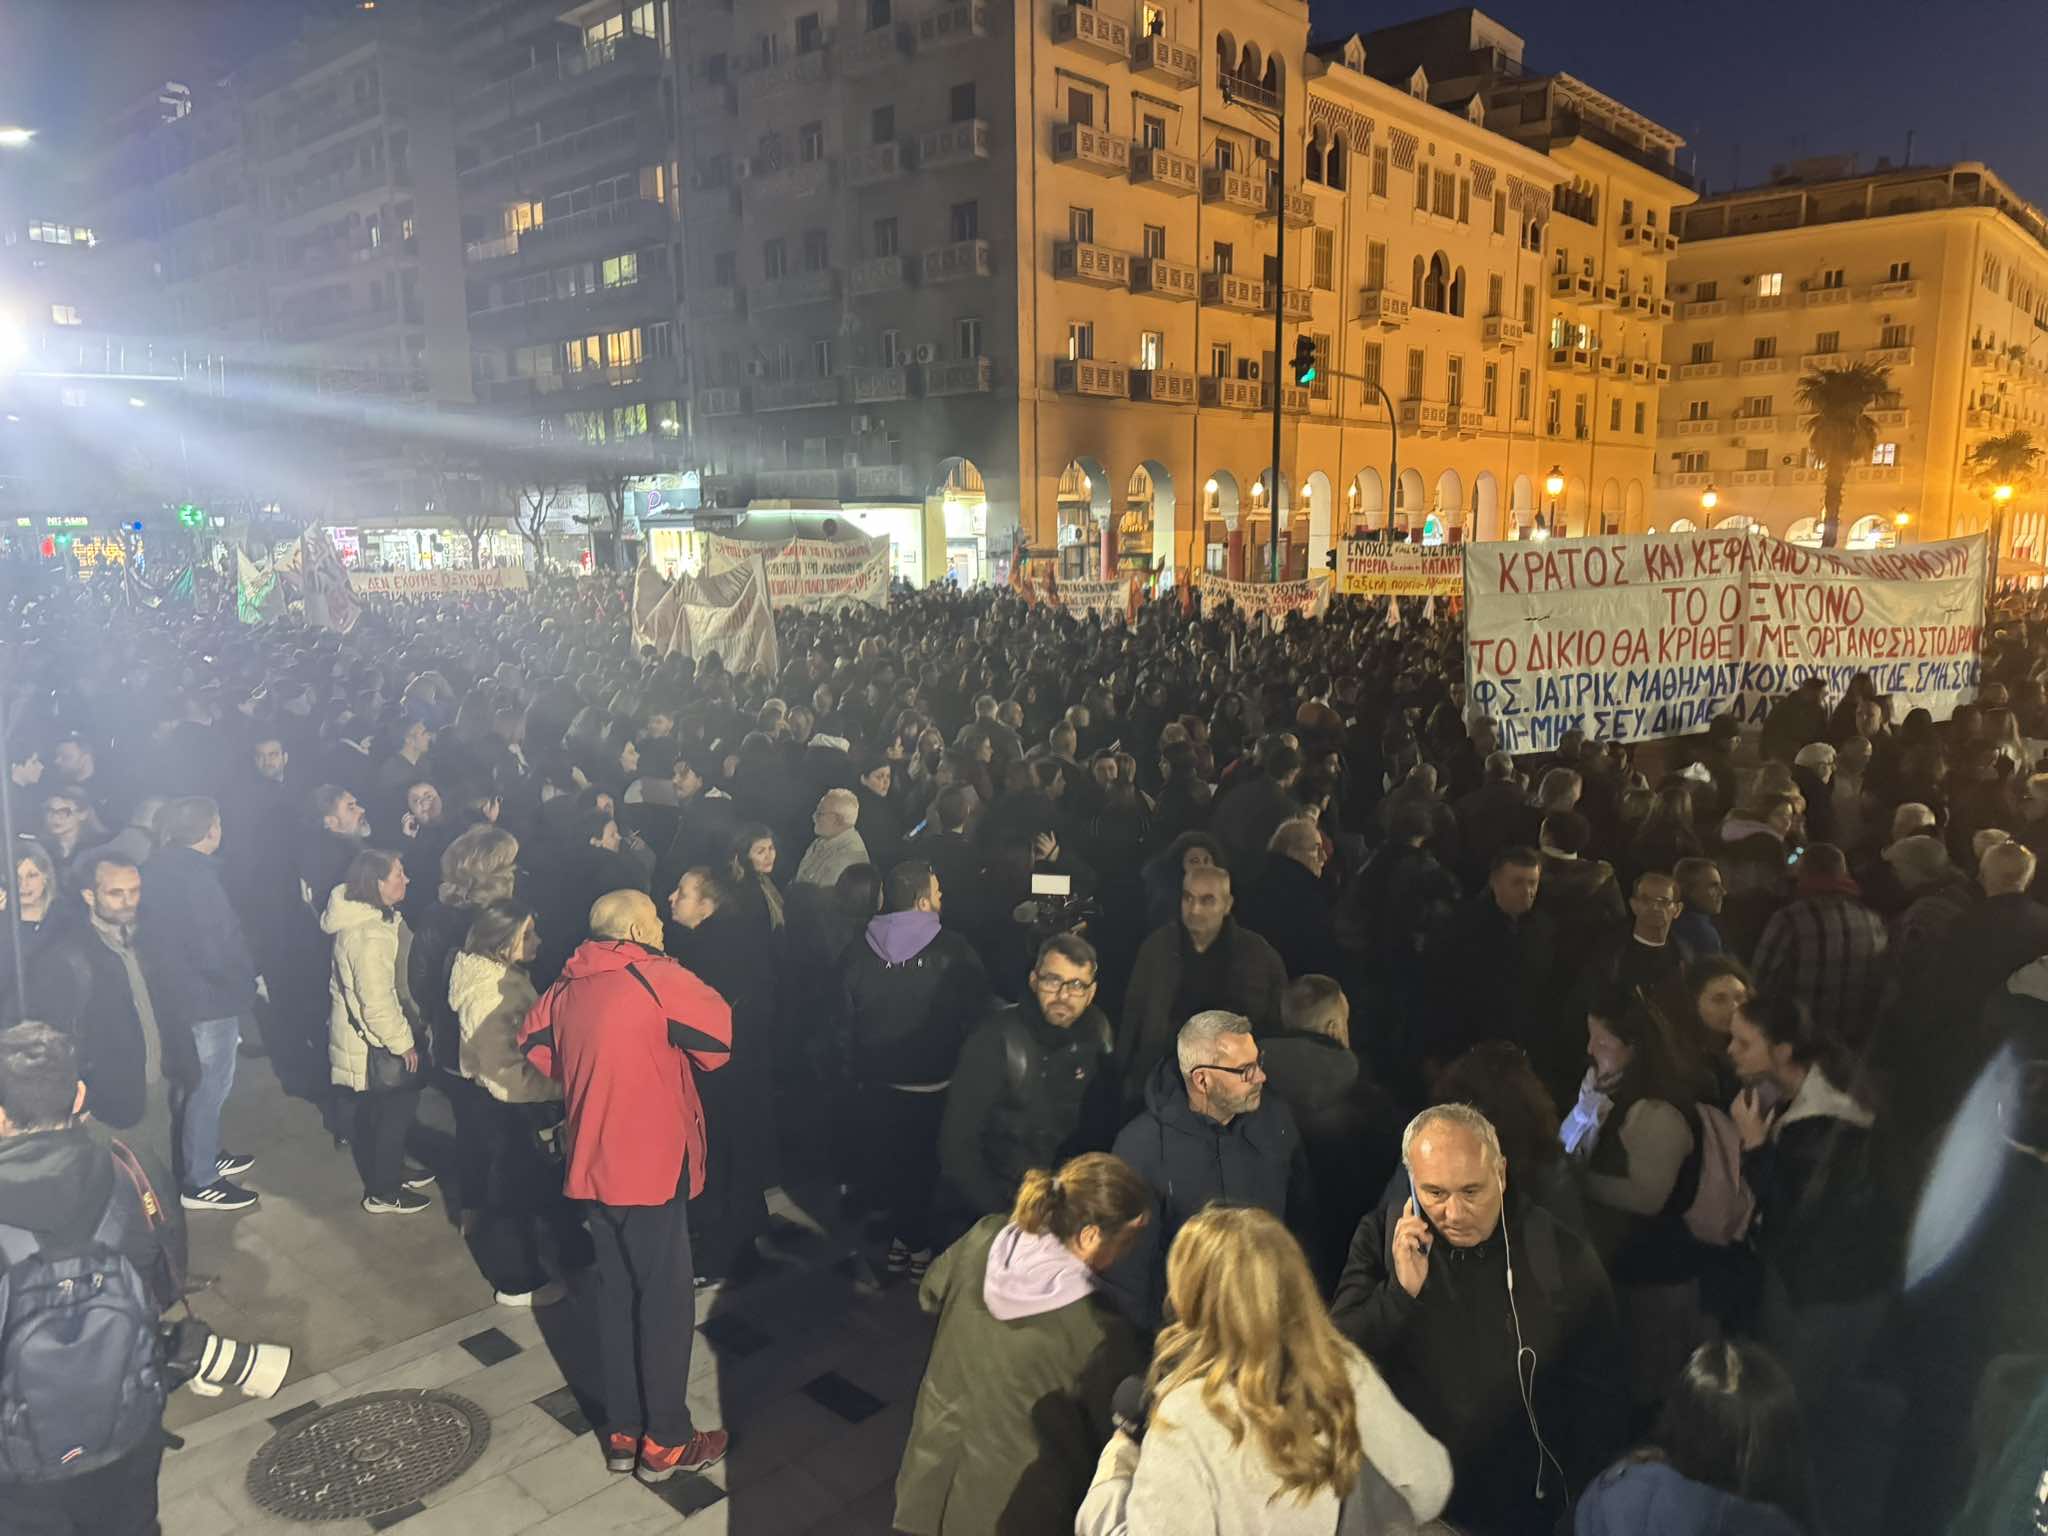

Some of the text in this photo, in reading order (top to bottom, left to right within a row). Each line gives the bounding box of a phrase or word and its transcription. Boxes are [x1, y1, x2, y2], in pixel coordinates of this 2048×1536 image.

[1347, 542, 1393, 557] ΕΝΟΧΟΣ
[1347, 557, 1390, 575] ΤΙΜΩΡΙΑ
[1498, 545, 1630, 594] ΚΡΑΤΟΣ
[1643, 543, 1685, 583] ΚΑΙ
[368, 576, 391, 592] ΔΕΝ
[394, 573, 436, 590] ΕΧΟΥΜΕ
[1662, 583, 1864, 626] ΤΟ ΟΞΥΓΟΝΟ
[1470, 637, 1517, 676] ΤΟ
[1527, 629, 1606, 672] ΔΙΚΙΟ
[1612, 627, 1651, 667] ΘΑ
[1658, 623, 1745, 664] ΚΡΙΘΕΙ
[1757, 624, 1801, 658] ΜΕ
[1807, 625, 1915, 658] ΟΡΓΑΝΩΣΗ
[1918, 626, 1947, 658] ΣΤΟ
